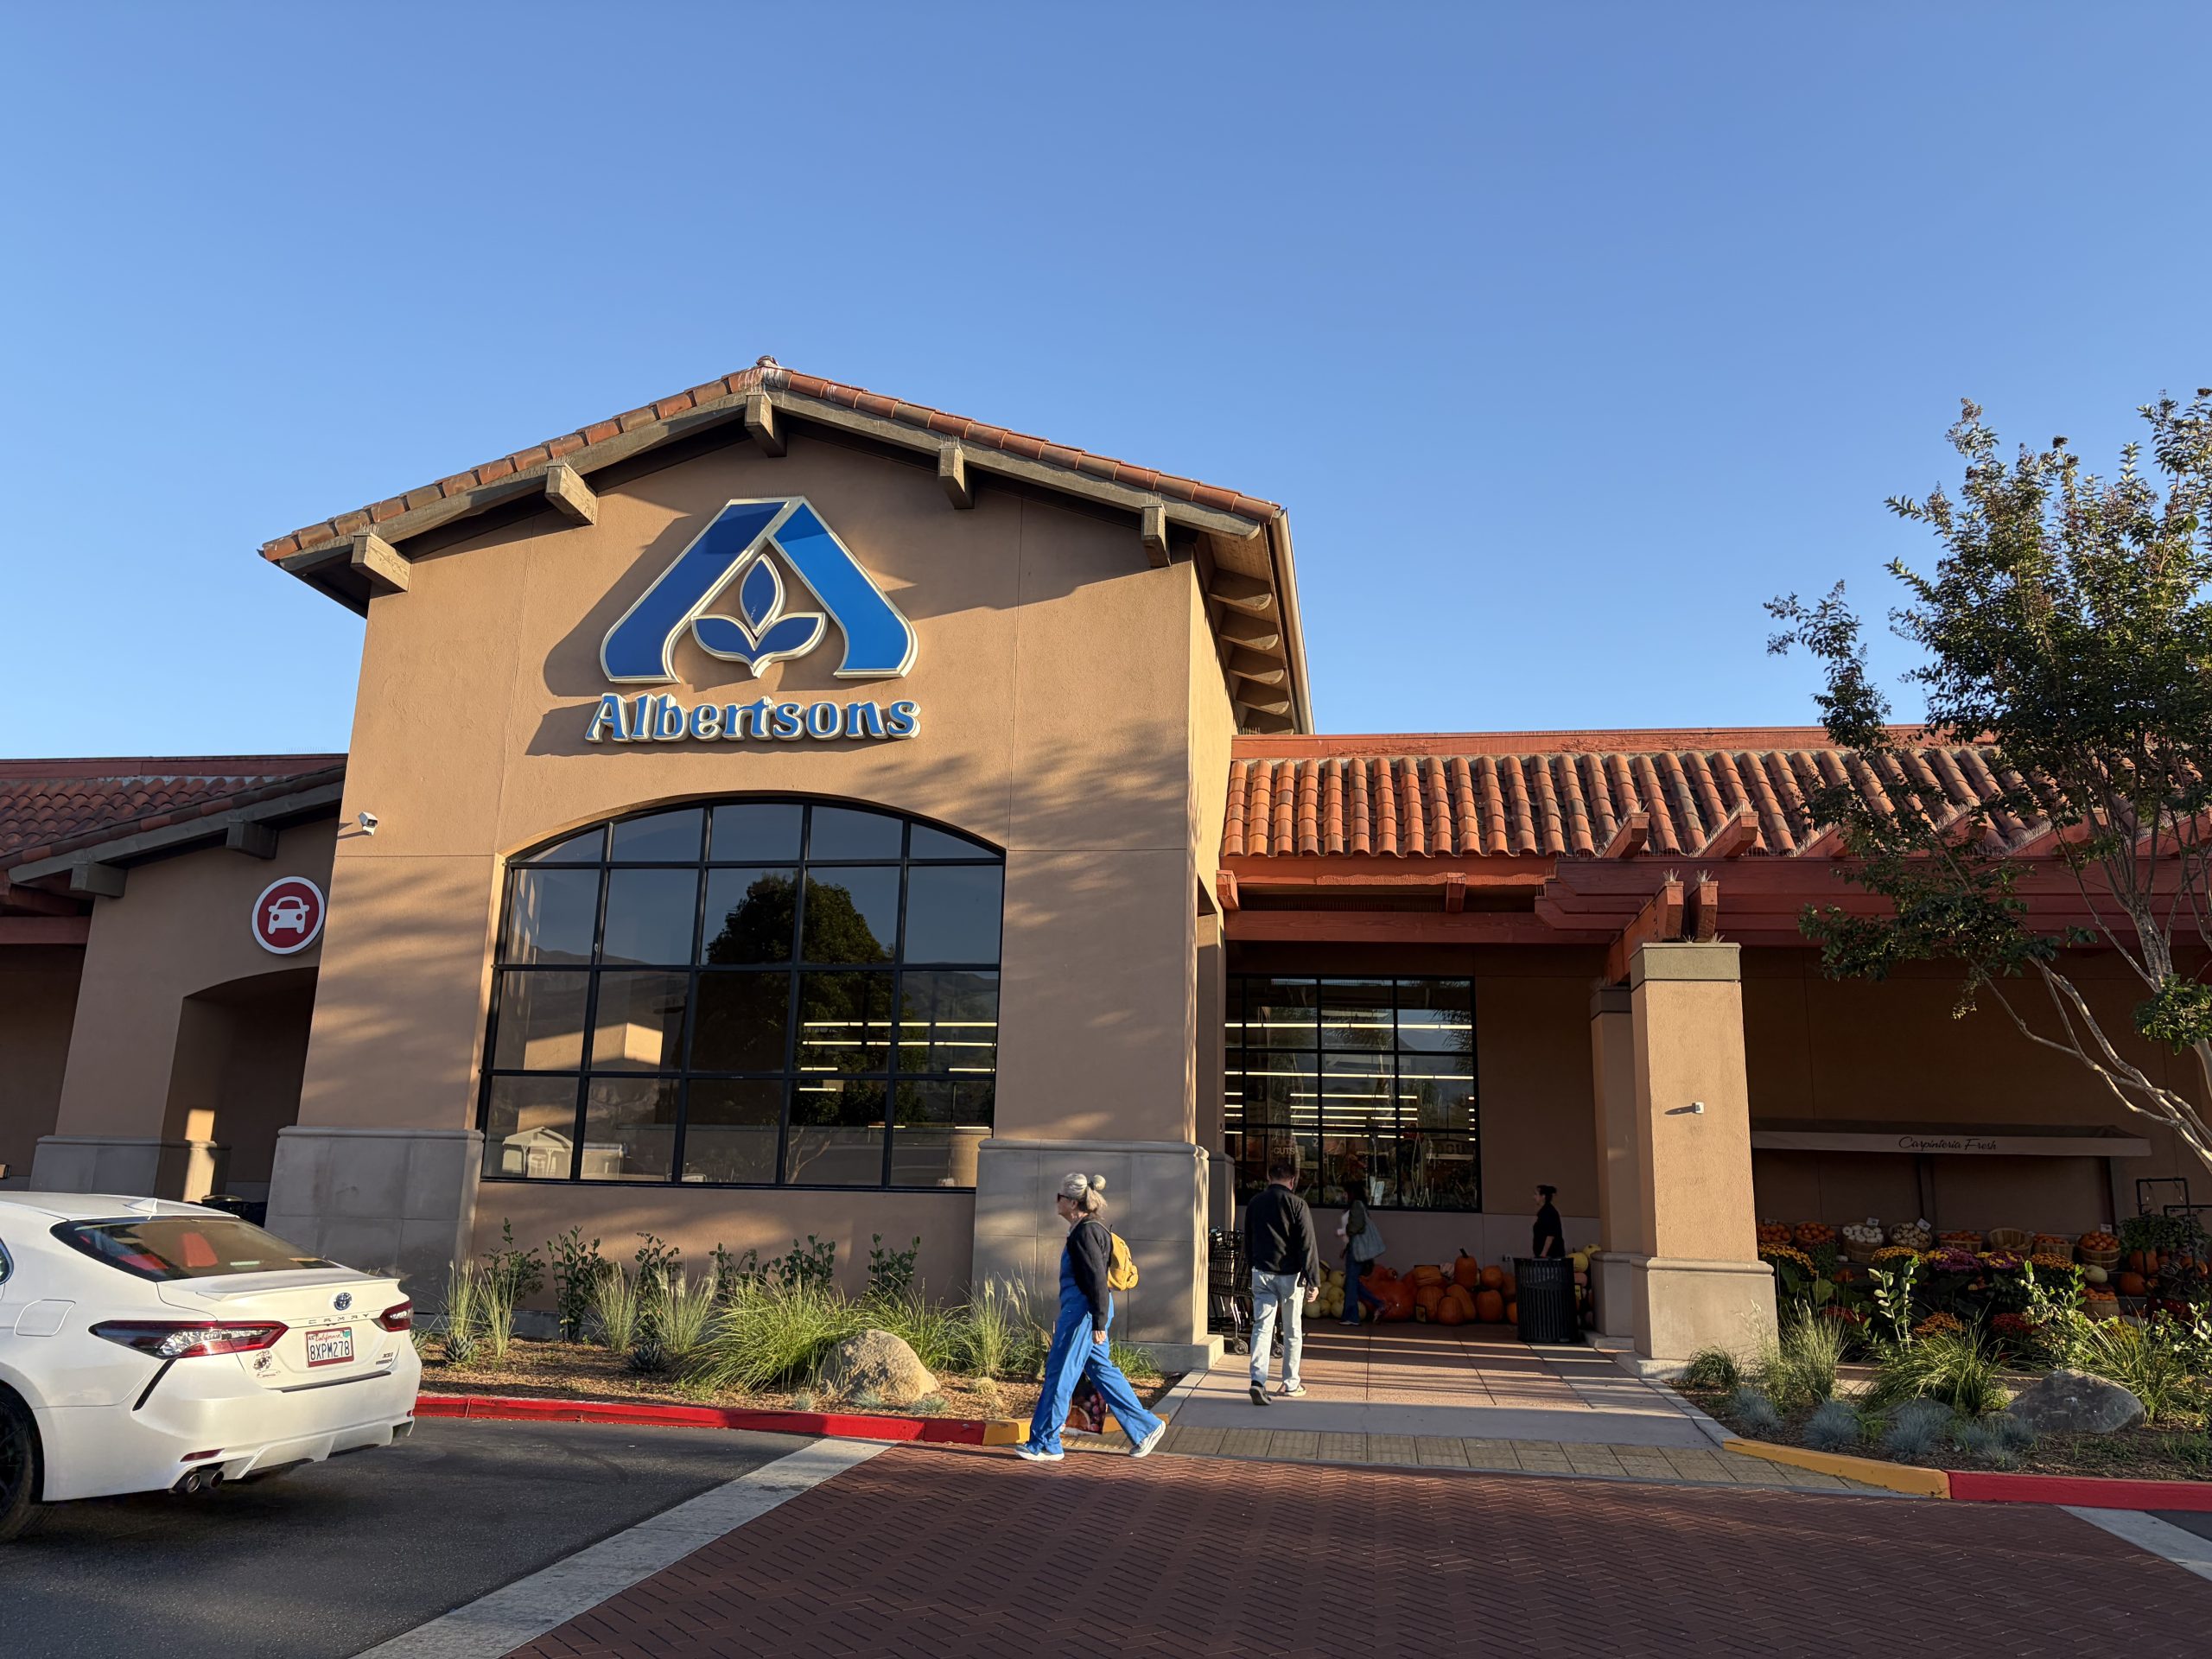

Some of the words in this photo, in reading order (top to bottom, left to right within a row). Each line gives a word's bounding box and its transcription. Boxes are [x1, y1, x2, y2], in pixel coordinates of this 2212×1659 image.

[584, 692, 922, 743] Albertsons
[1898, 1135, 1961, 1151] Carpinteria
[1964, 1138, 1997, 1151] Fresh
[308, 1313, 370, 1325] CAMRY
[309, 1340, 350, 1361] 8XPM278
